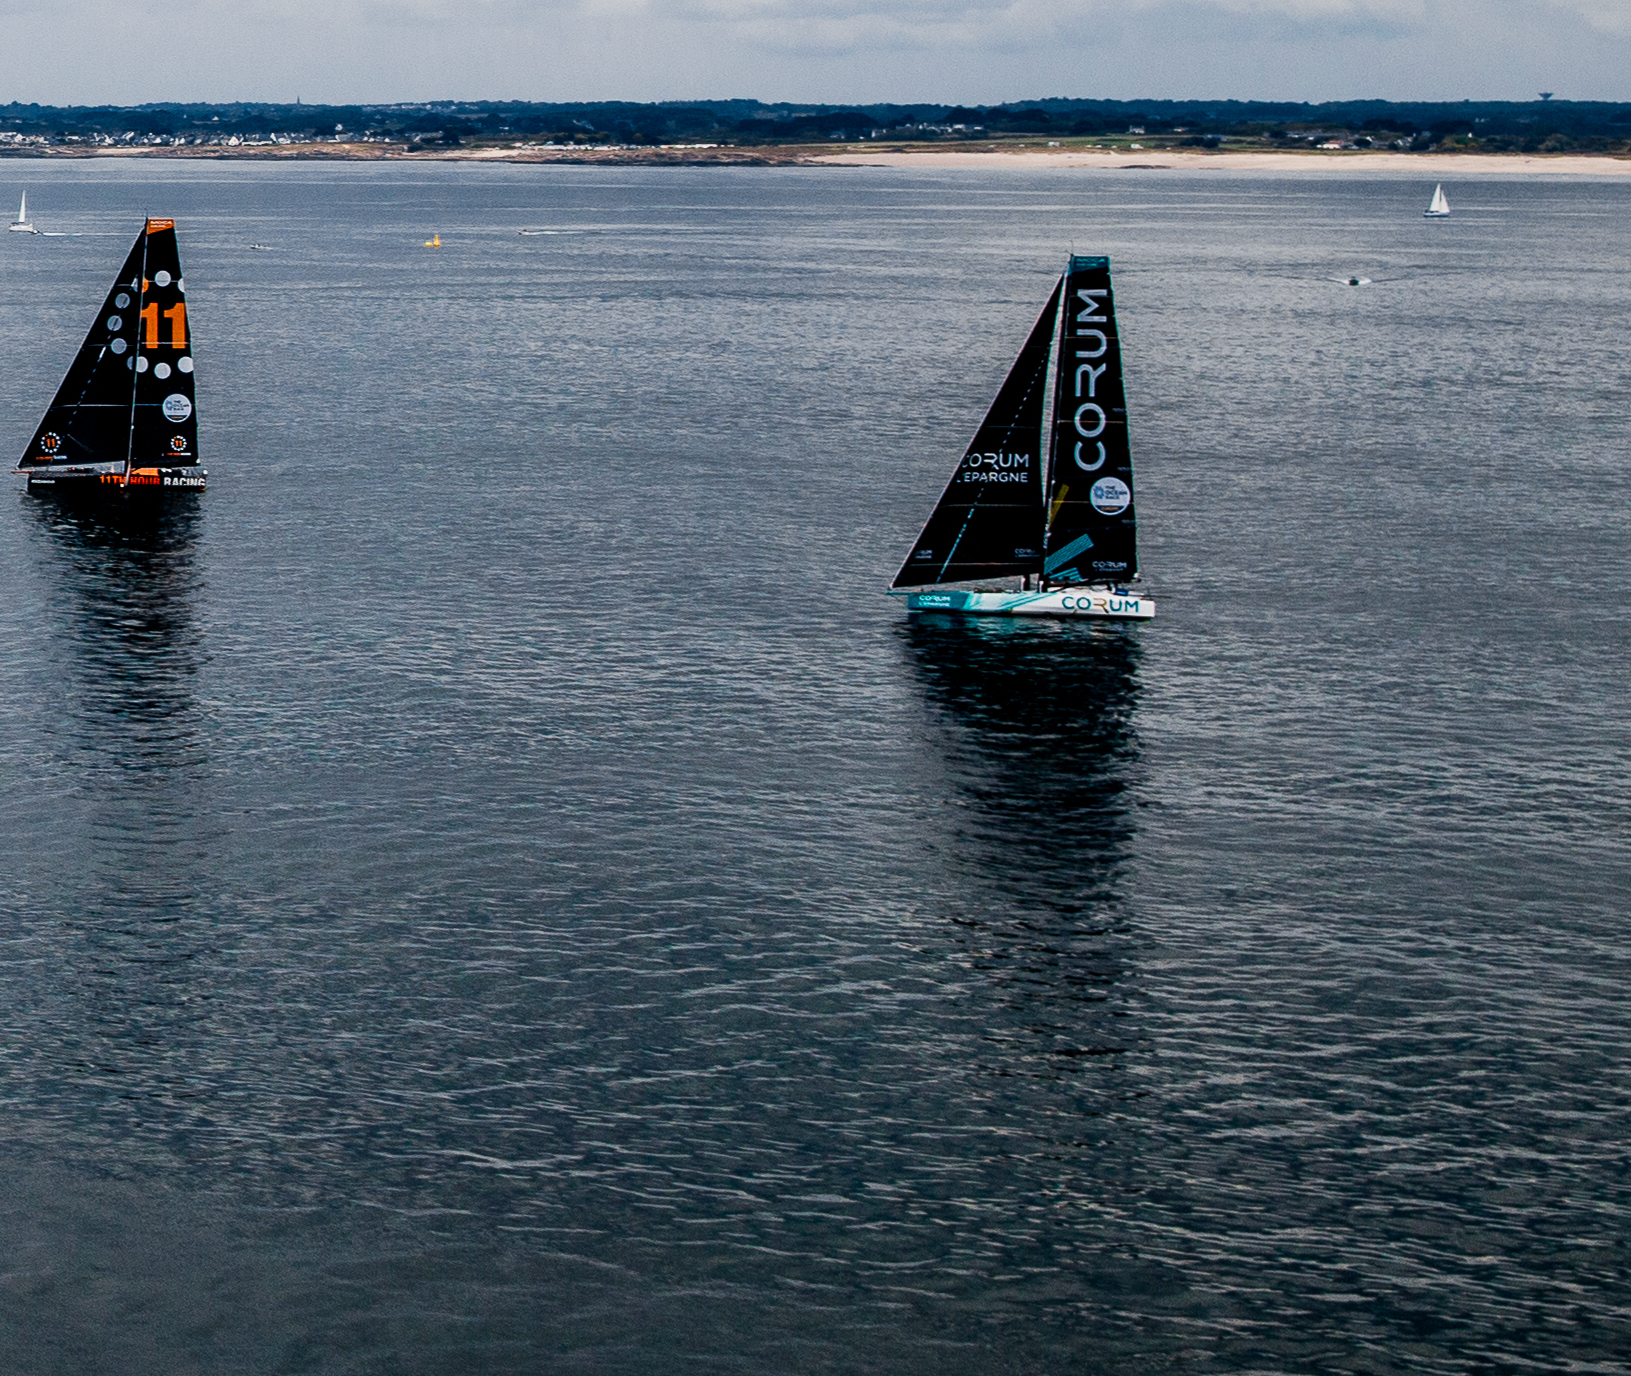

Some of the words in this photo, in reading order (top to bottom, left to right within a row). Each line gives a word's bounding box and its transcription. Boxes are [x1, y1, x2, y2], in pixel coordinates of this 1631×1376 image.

[141, 302, 187, 349] 11
[1074, 289, 1107, 471] CORUM
[130, 476, 160, 485] HOUR
[163, 477, 206, 486] RACING
[1061, 596, 1139, 614] CORUM
